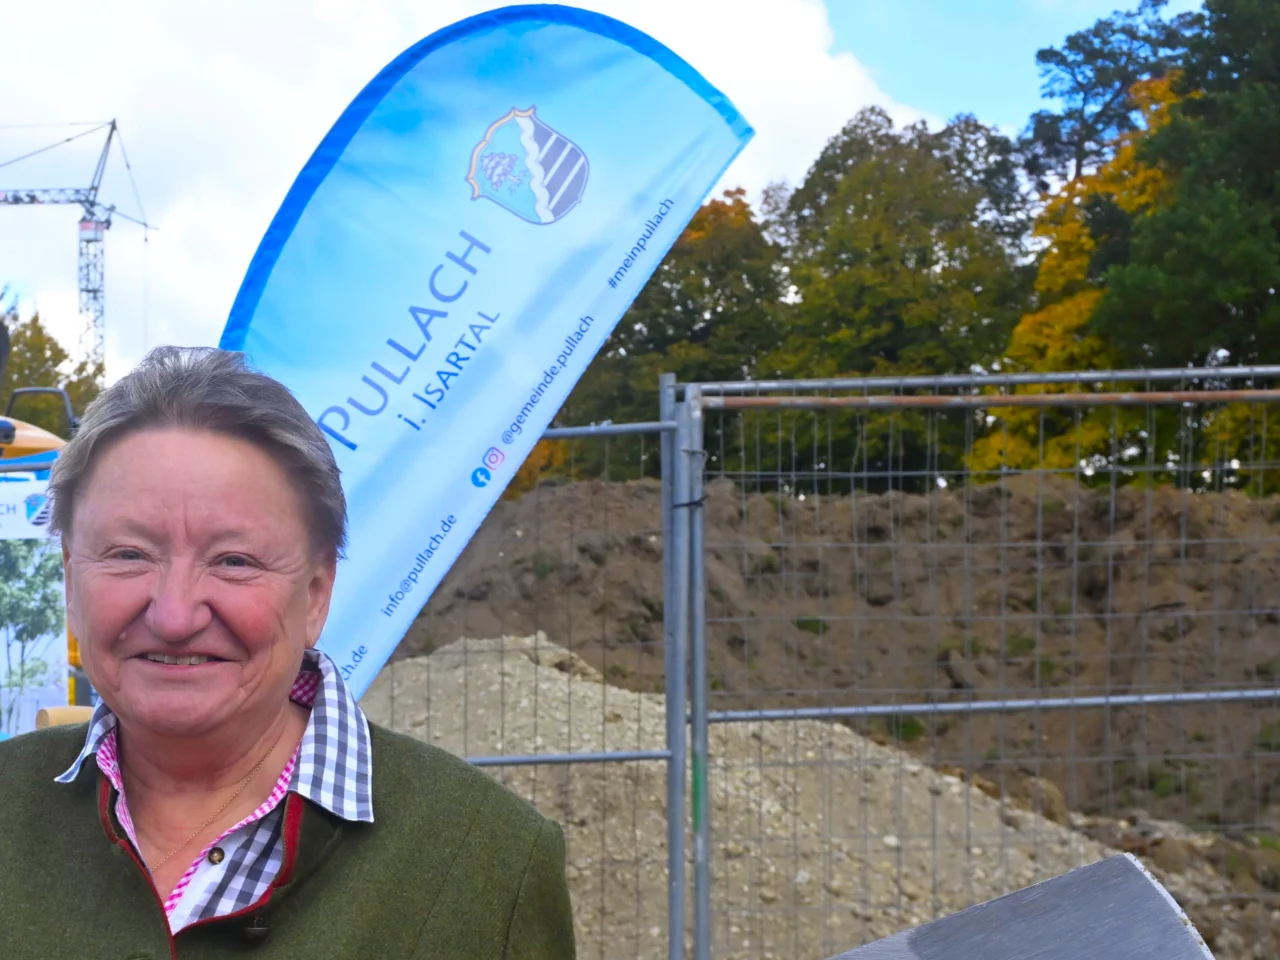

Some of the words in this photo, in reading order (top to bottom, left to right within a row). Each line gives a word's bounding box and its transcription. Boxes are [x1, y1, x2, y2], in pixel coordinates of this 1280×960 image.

[607, 196, 674, 289] #meinpullach
[317, 229, 492, 451] PULLACH
[397, 413, 426, 431] i.
[412, 311, 501, 410] ISARTAL
[501, 313, 595, 446] @gemeinde.pullach
[380, 512, 458, 618] info@pullach.de
